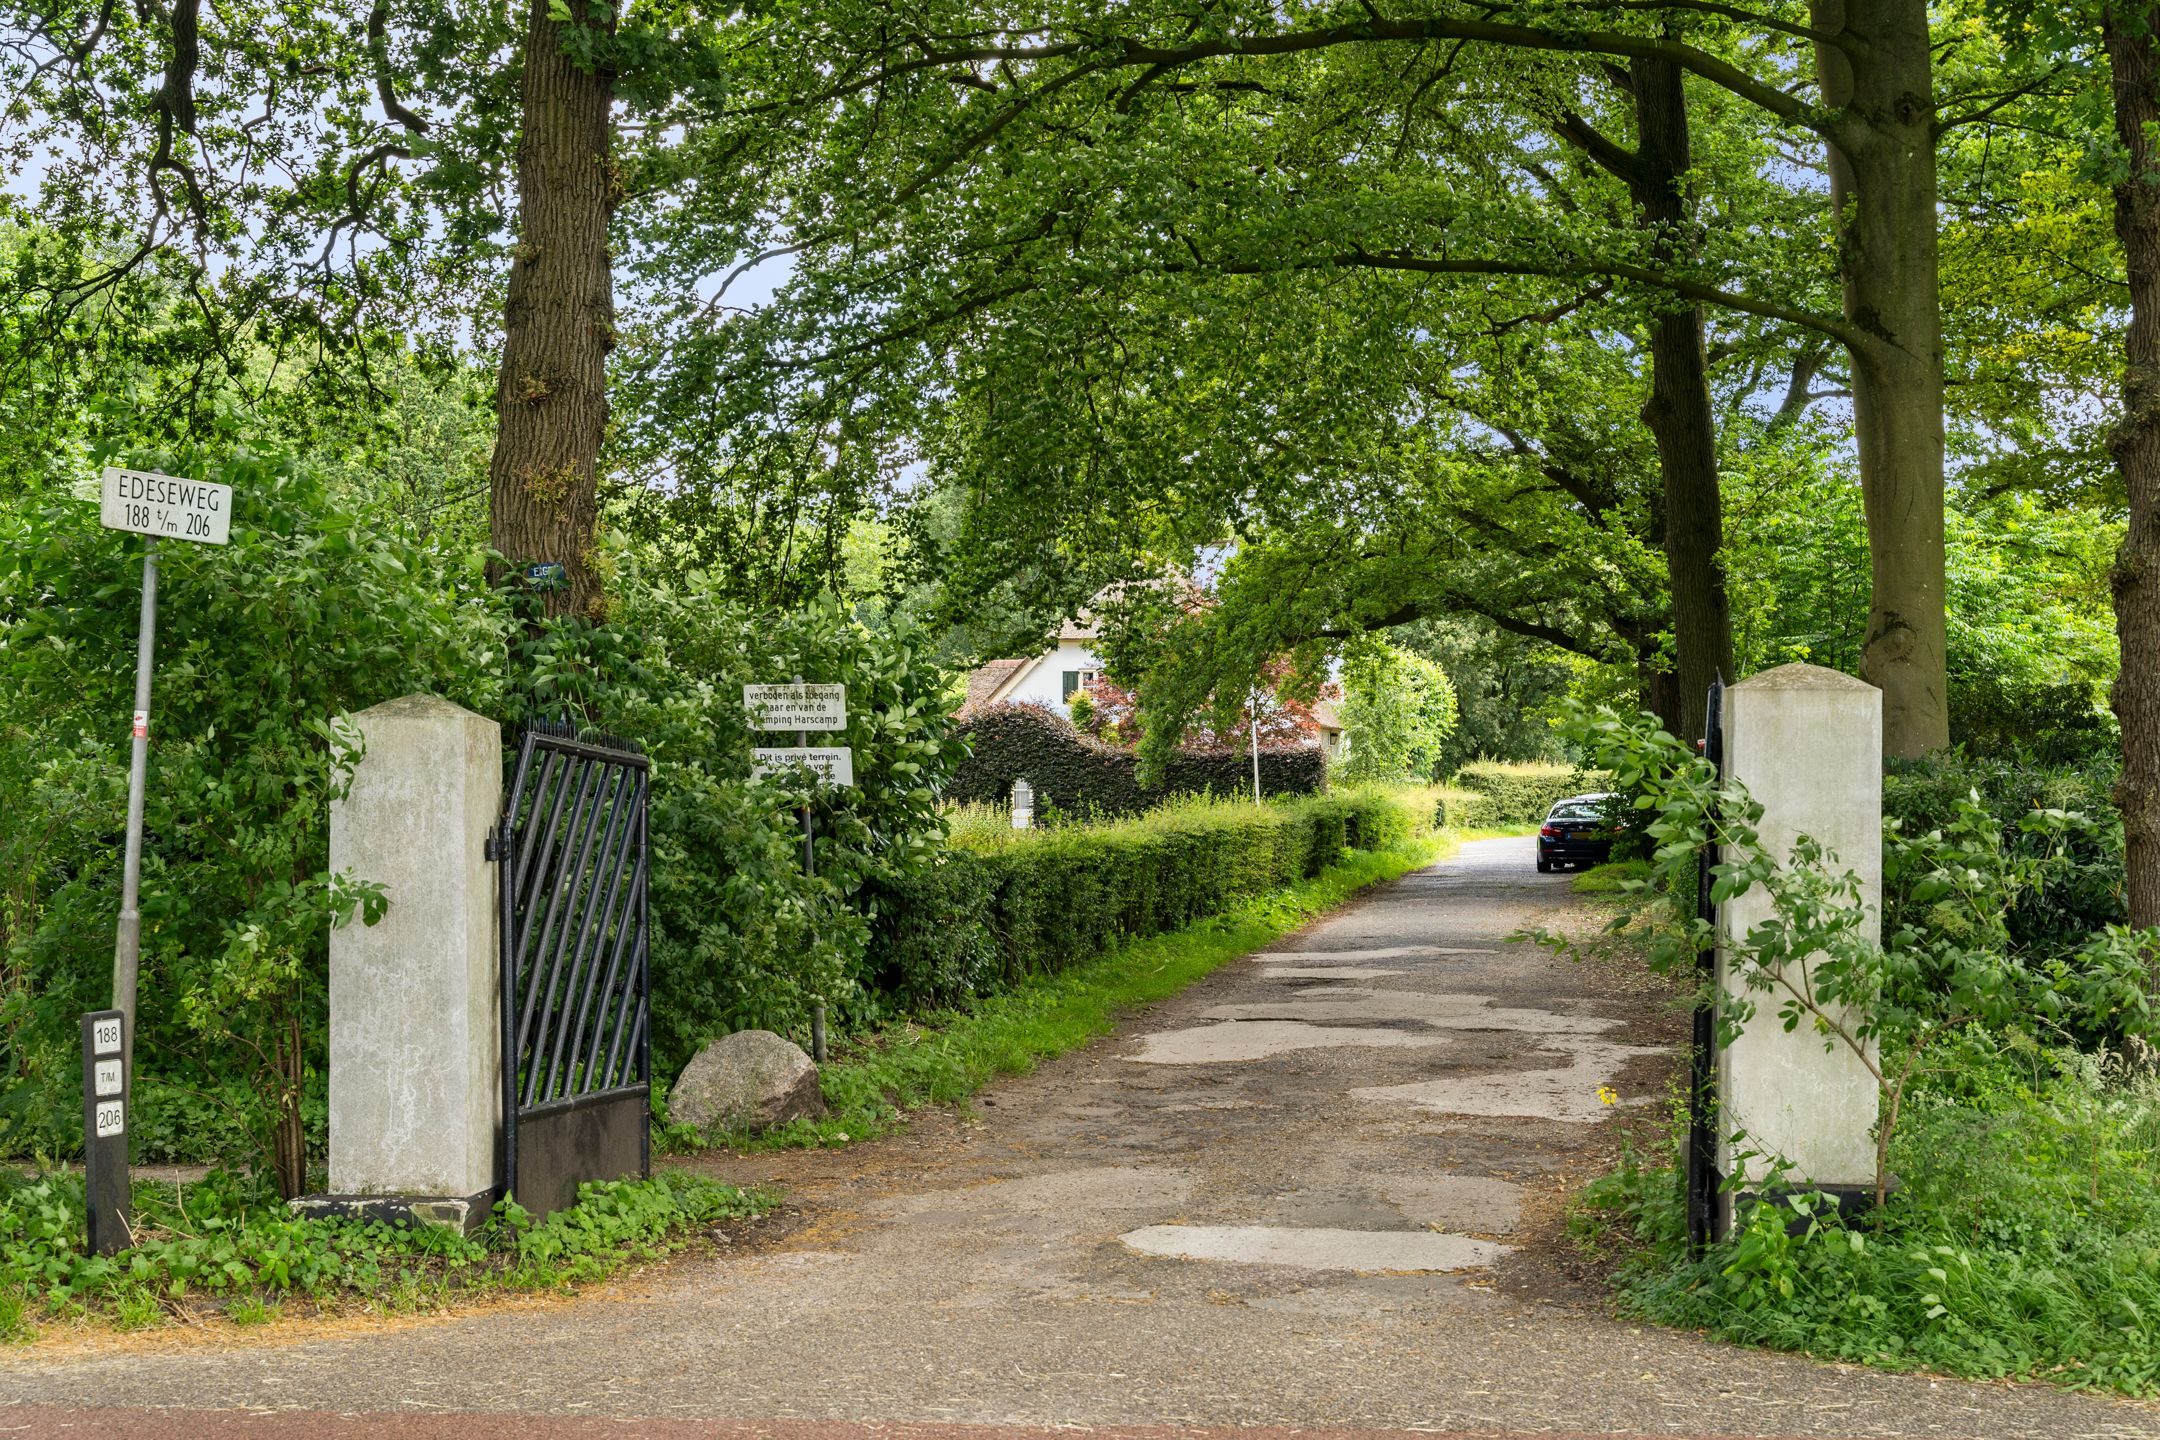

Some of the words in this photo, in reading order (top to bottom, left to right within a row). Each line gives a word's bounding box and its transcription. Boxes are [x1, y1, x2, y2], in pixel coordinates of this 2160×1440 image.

[119, 475, 219, 511] EDESEWEG
[125, 504, 150, 528] 188
[157, 509, 178, 532] t/m
[186, 513, 210, 537] 206
[749, 691, 789, 700] verboden
[790, 691, 803, 700] als
[805, 691, 840, 702] toegang
[786, 703, 796, 712] en
[798, 703, 815, 712] van
[816, 702, 827, 712] de
[763, 714, 792, 726] mping
[794, 715, 838, 725] Harscamp
[775, 753, 783, 761] is
[809, 753, 842, 761] terrein.
[97, 1026, 118, 1044] 188
[98, 1110, 121, 1129] 206
